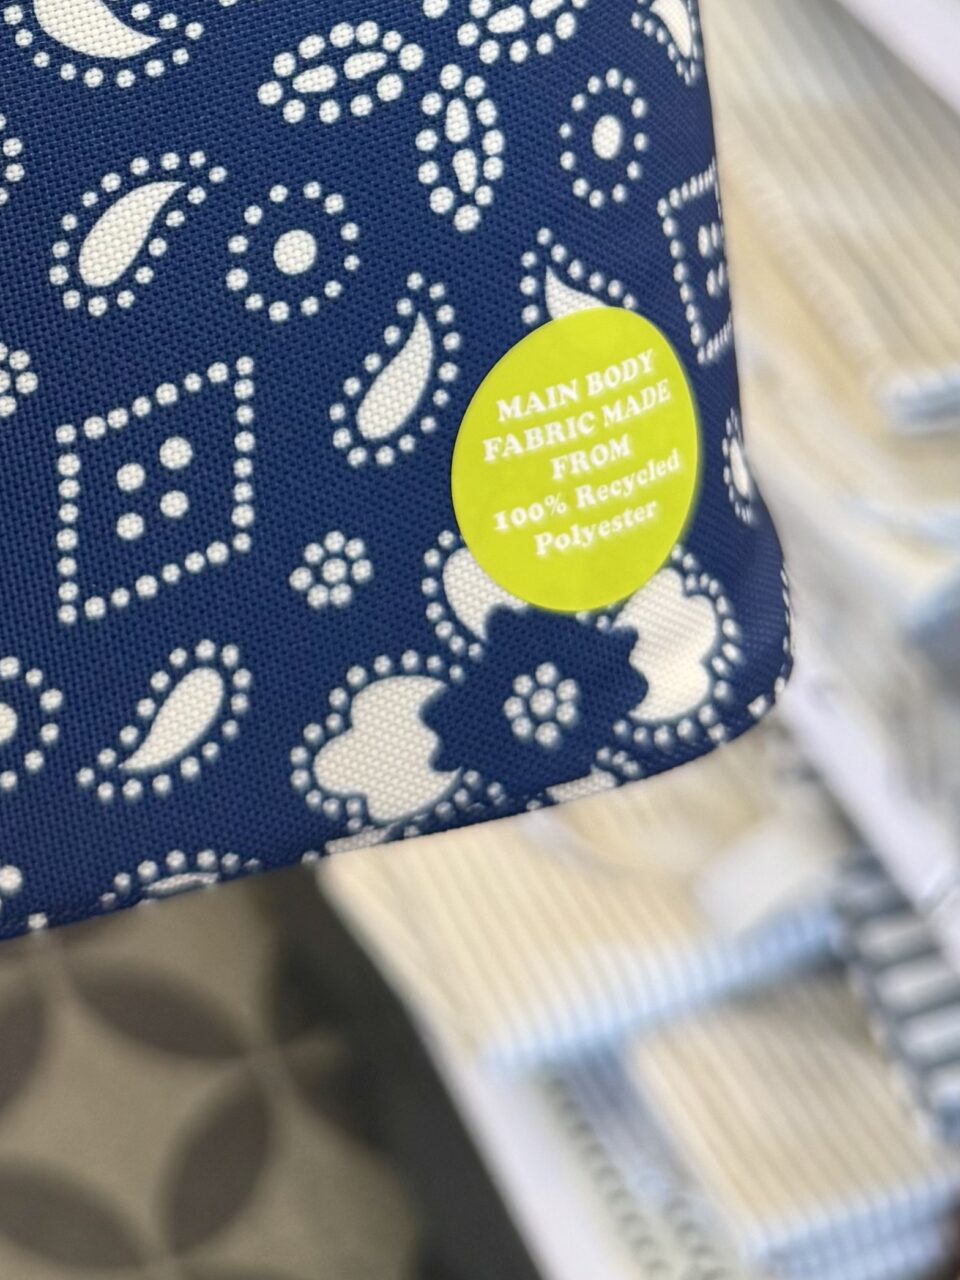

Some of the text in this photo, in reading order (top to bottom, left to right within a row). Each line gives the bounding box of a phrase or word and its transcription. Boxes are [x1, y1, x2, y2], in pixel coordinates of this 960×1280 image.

[483, 379, 671, 462] FABRIC MADE
[497, 348, 654, 421] MAIN BODY
[494, 449, 680, 531] 100% Recycled
[550, 434, 631, 480] FROM
[534, 500, 657, 556] Polyester
